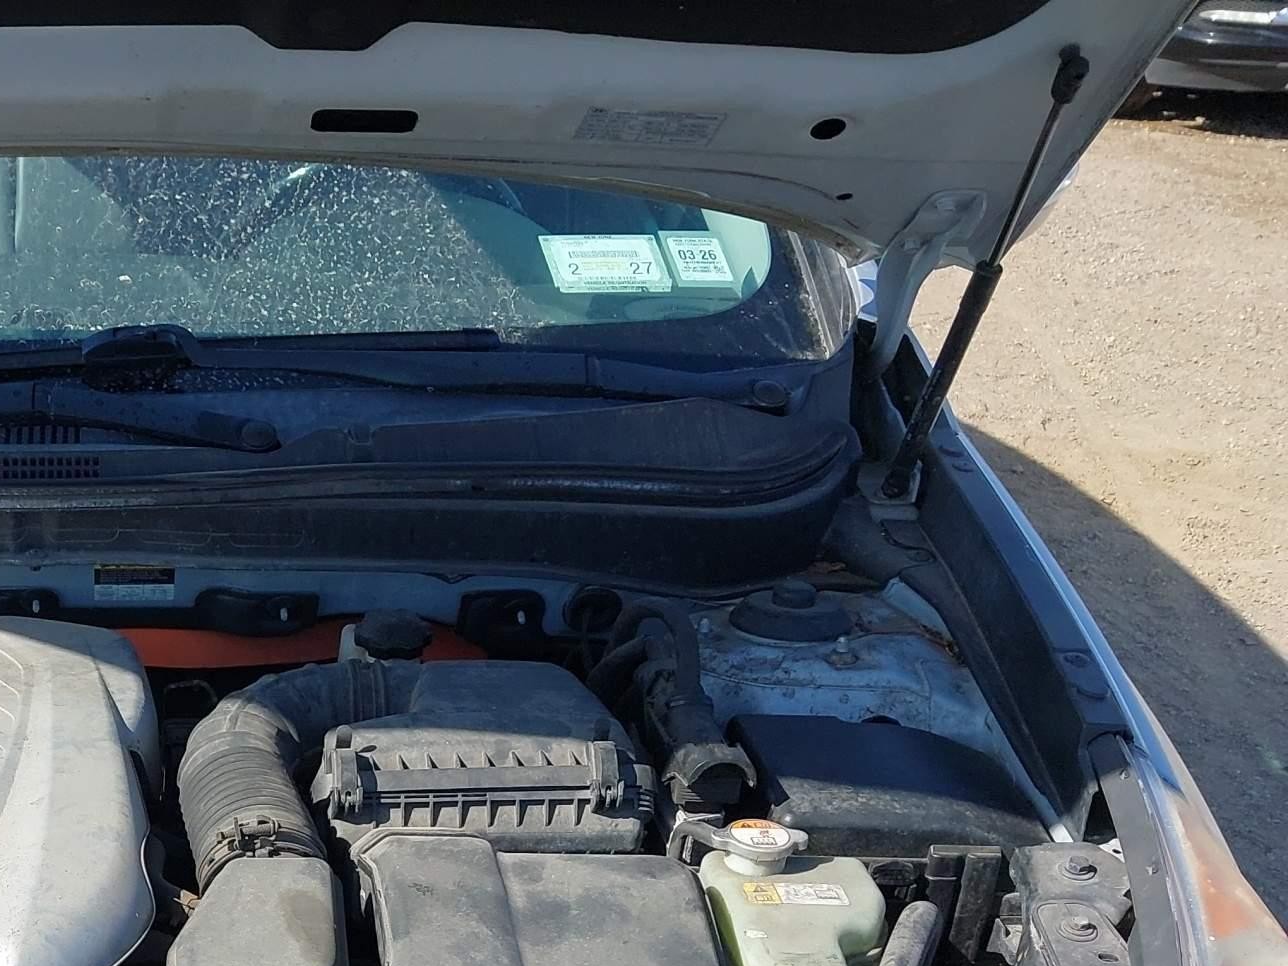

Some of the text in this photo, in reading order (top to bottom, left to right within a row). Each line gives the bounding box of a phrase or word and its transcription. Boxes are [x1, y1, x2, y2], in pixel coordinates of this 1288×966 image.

[678, 249, 717, 260] 03 26
[568, 263, 582, 275] 2
[630, 261, 653, 275] 27
